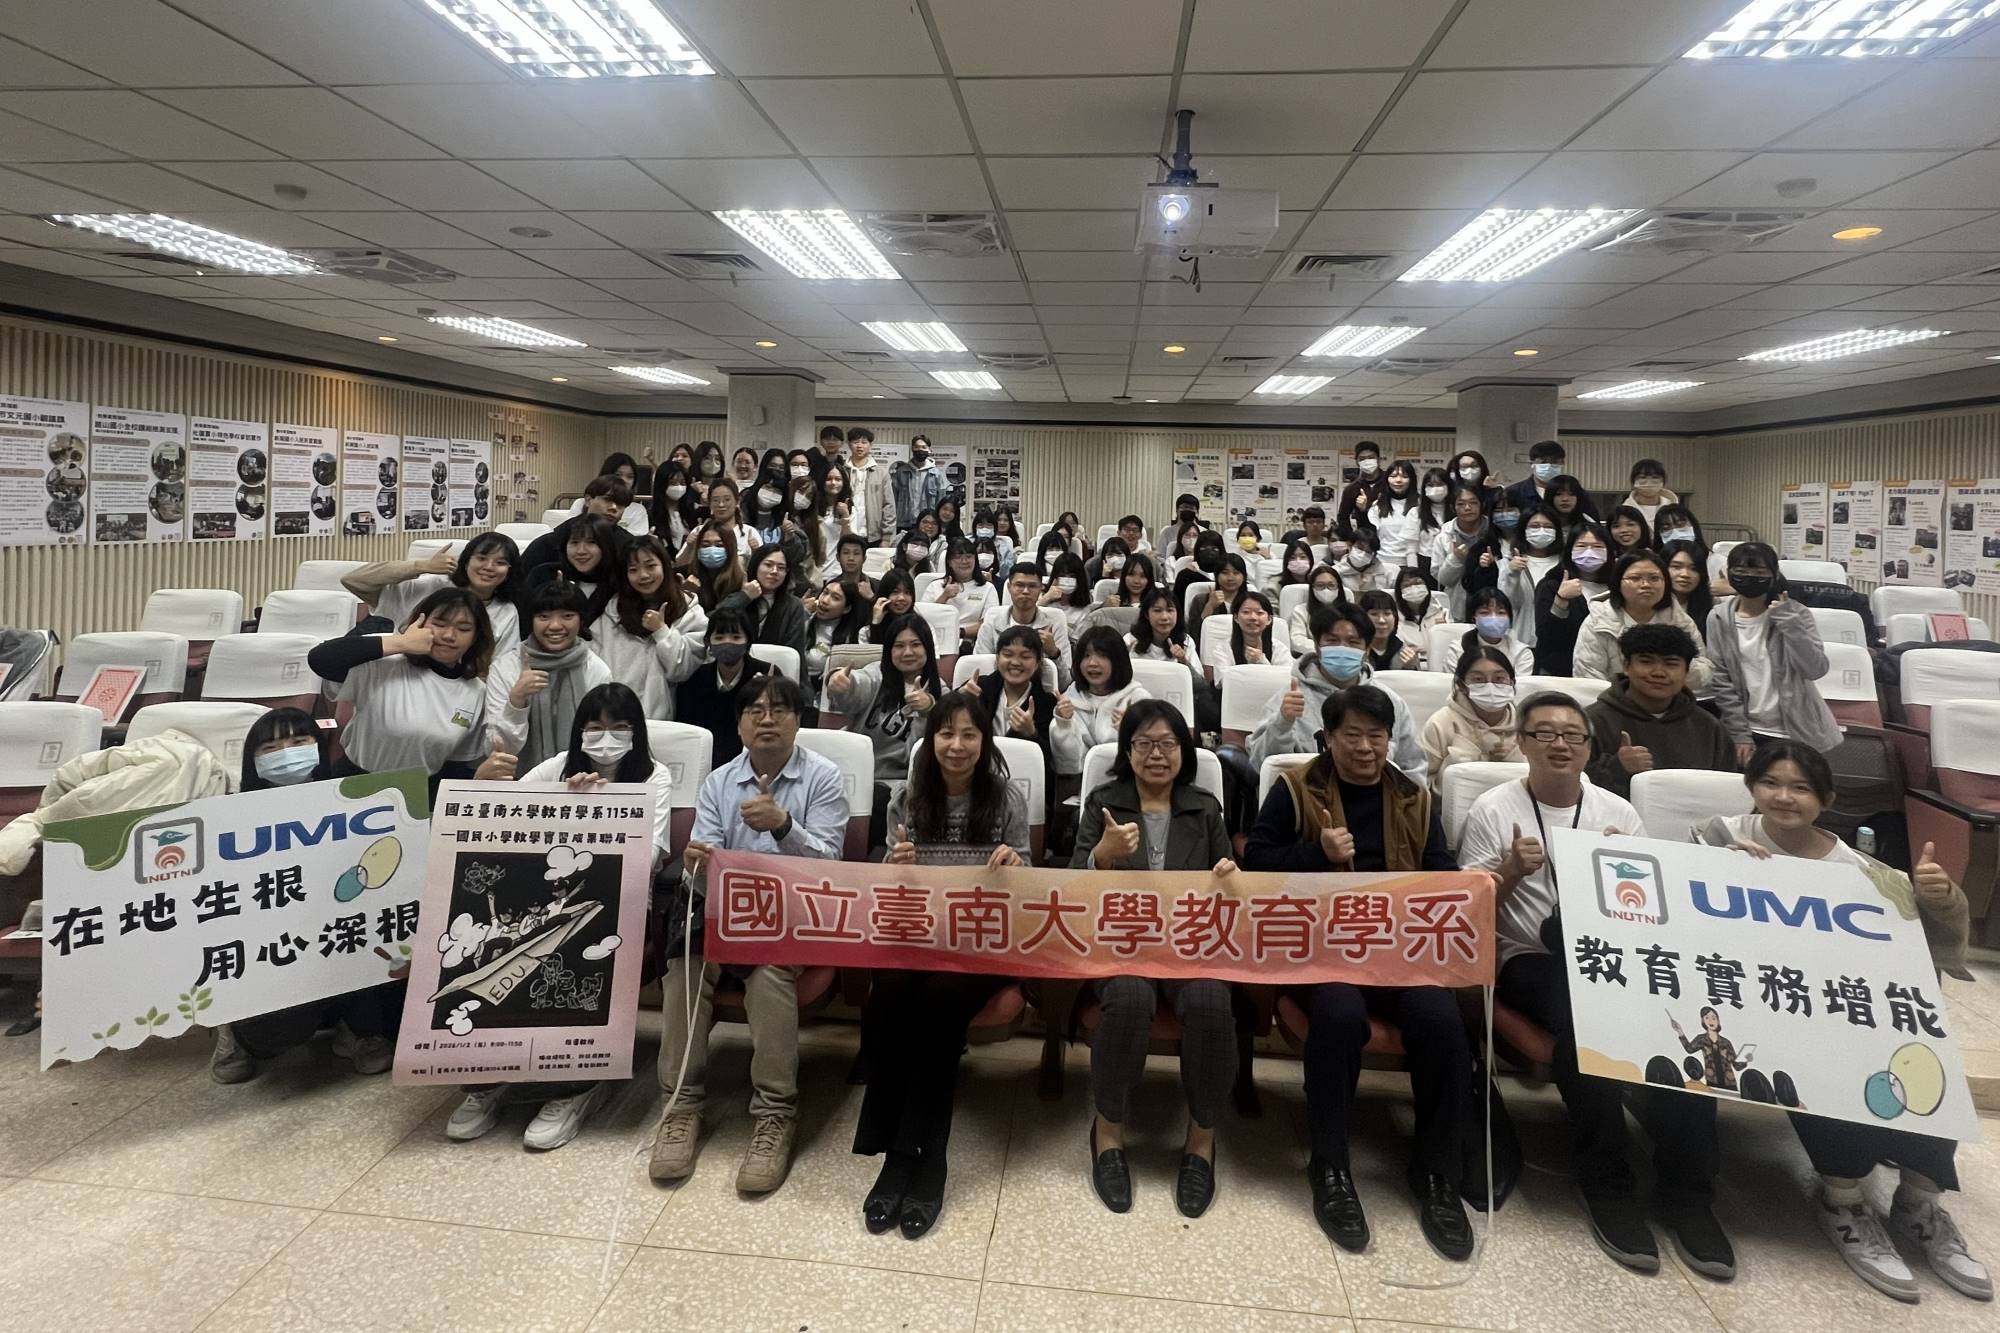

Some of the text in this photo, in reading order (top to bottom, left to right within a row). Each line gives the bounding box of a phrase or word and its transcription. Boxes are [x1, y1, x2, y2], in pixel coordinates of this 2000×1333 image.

[219, 805, 396, 861] UMC
[148, 868, 191, 884] NUTN
[48, 864, 308, 957] 在地生根
[717, 868, 1479, 964] 國立臺南大學教育學系
[1613, 910, 1656, 925] NUTN
[1688, 879, 1893, 942] UMC
[194, 899, 421, 987] 用心深根
[488, 966, 526, 1001] EDU
[1574, 934, 1948, 1039] 教育實務增能
